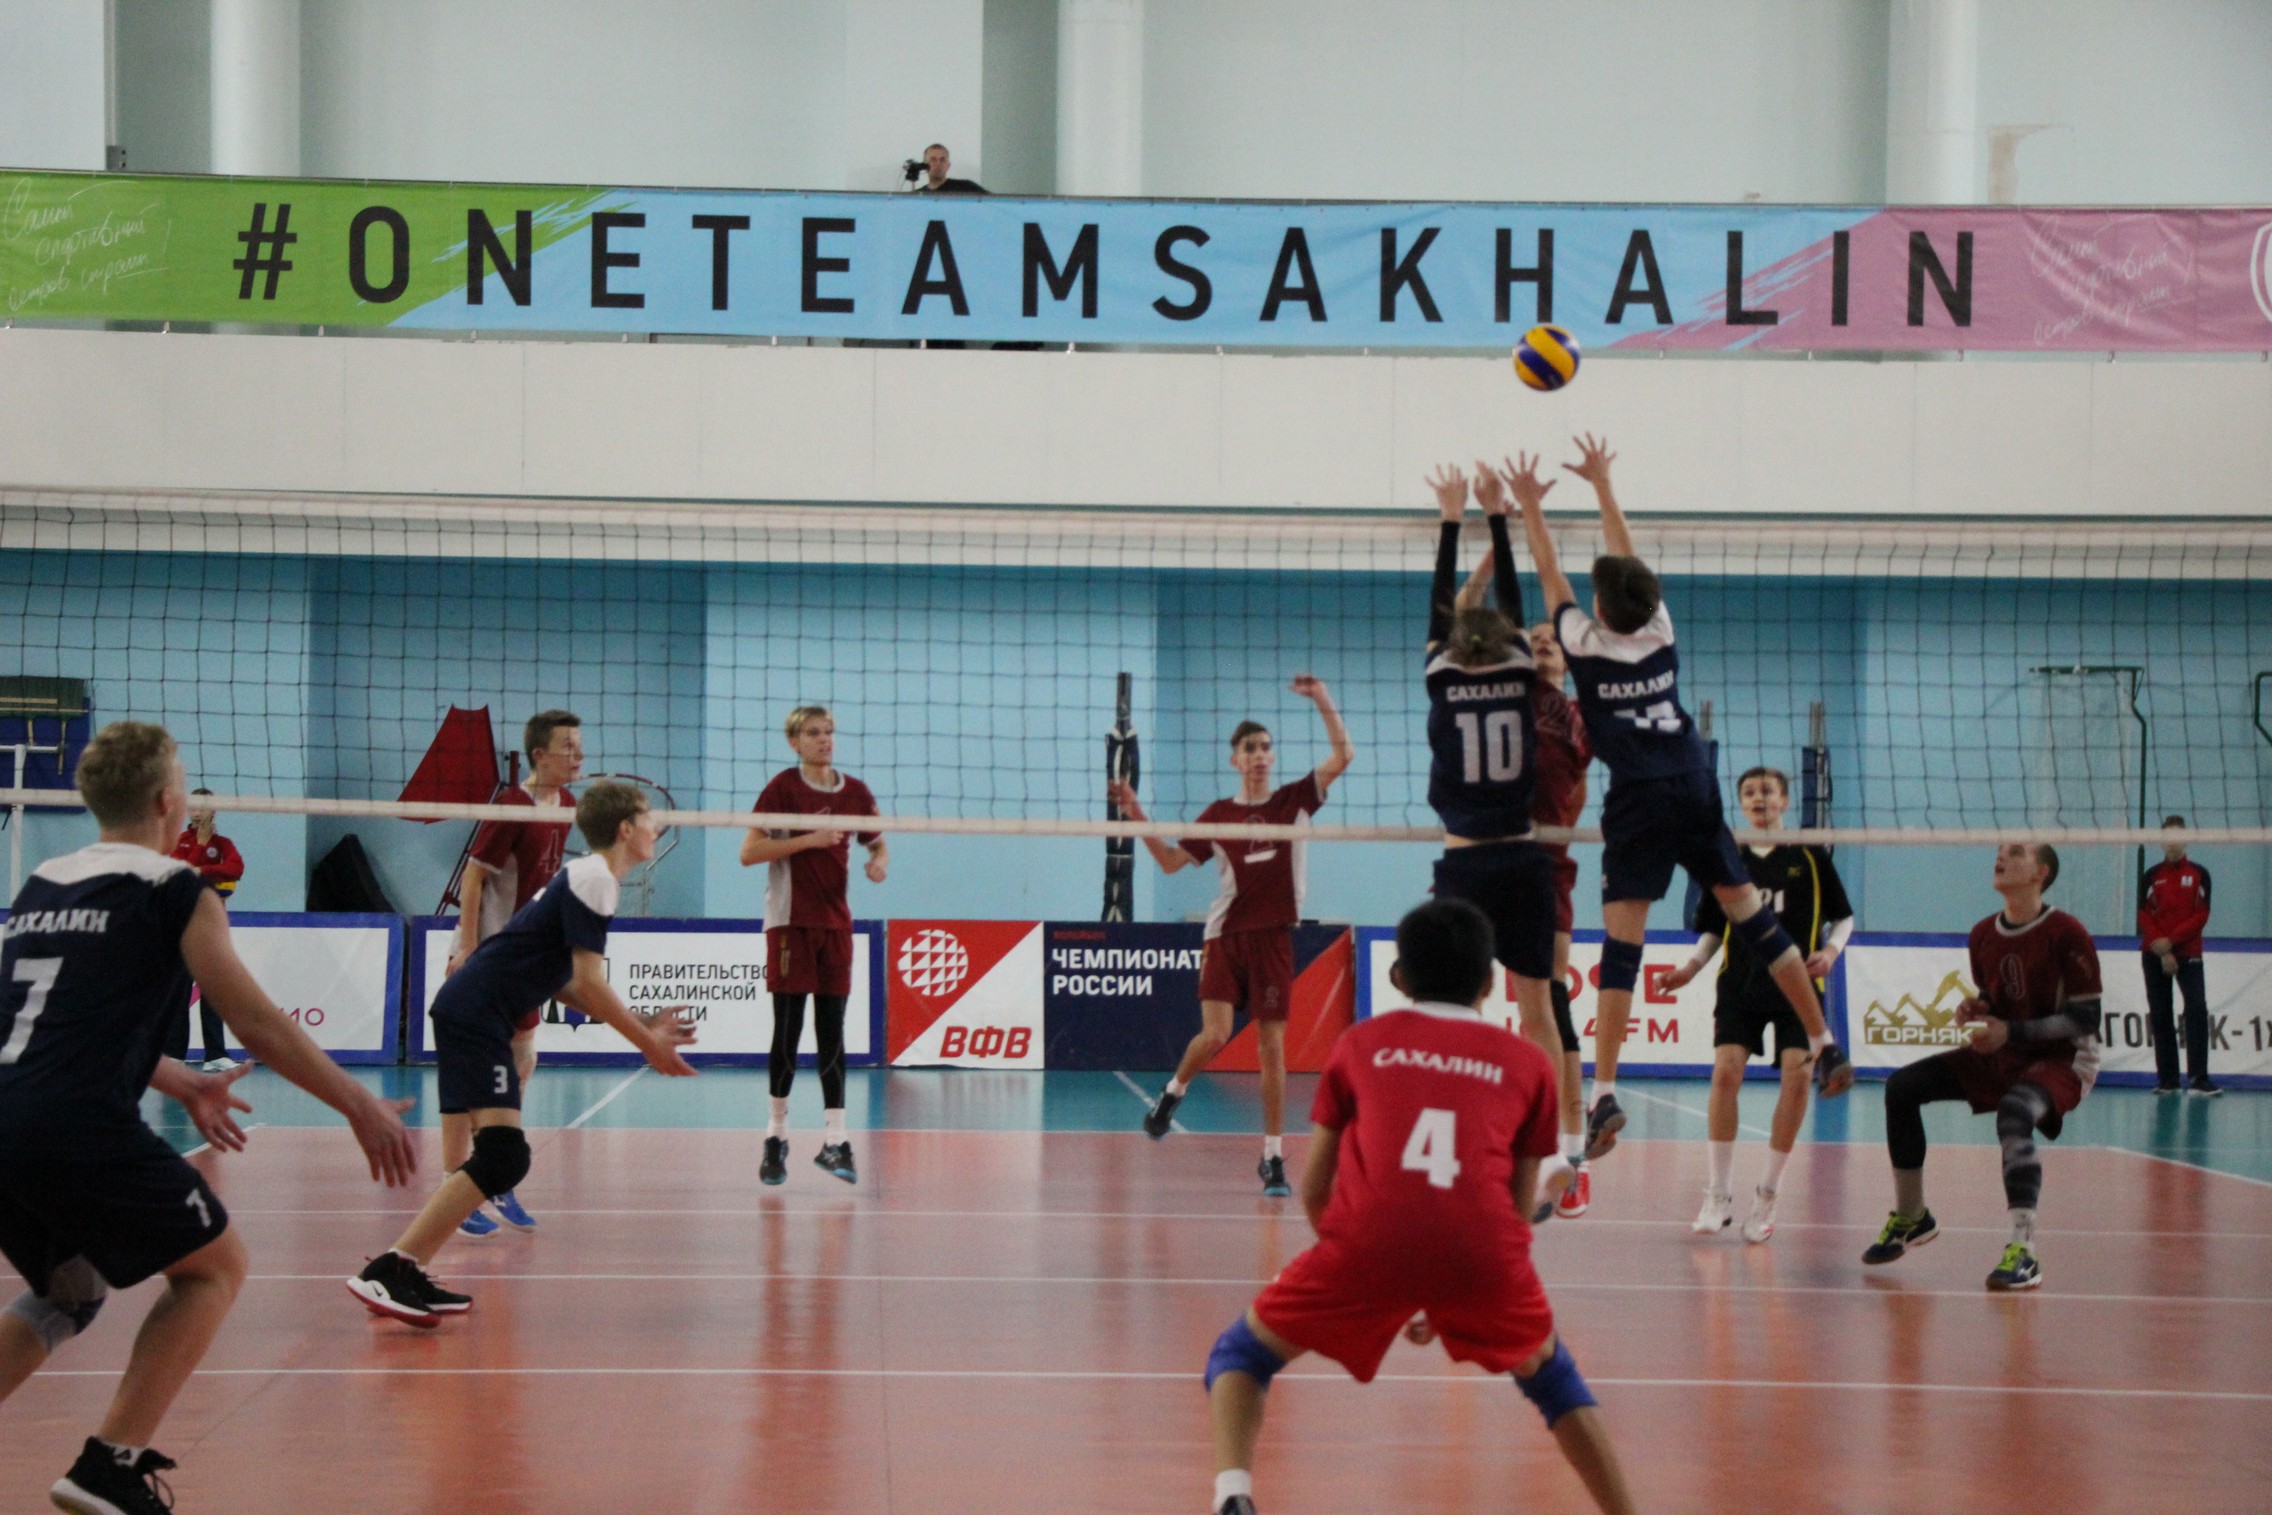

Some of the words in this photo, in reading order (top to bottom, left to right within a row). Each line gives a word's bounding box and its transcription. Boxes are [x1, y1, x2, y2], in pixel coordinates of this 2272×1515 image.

[1456, 709, 1523, 783] 10
[1052, 948, 1203, 970] ЧЕМПИОНАТ
[629, 982, 757, 1001] САХАЛИНСКОЙ
[1053, 975, 1153, 996] РОССИИ
[0, 957, 64, 1064] 7
[939, 1026, 1033, 1059] ВФВ
[1866, 1025, 1973, 1045] ГОРНЯК
[493, 1065, 508, 1094] 3
[1373, 1047, 1504, 1085] САХАЛИН
[1402, 1107, 1461, 1190] 4
